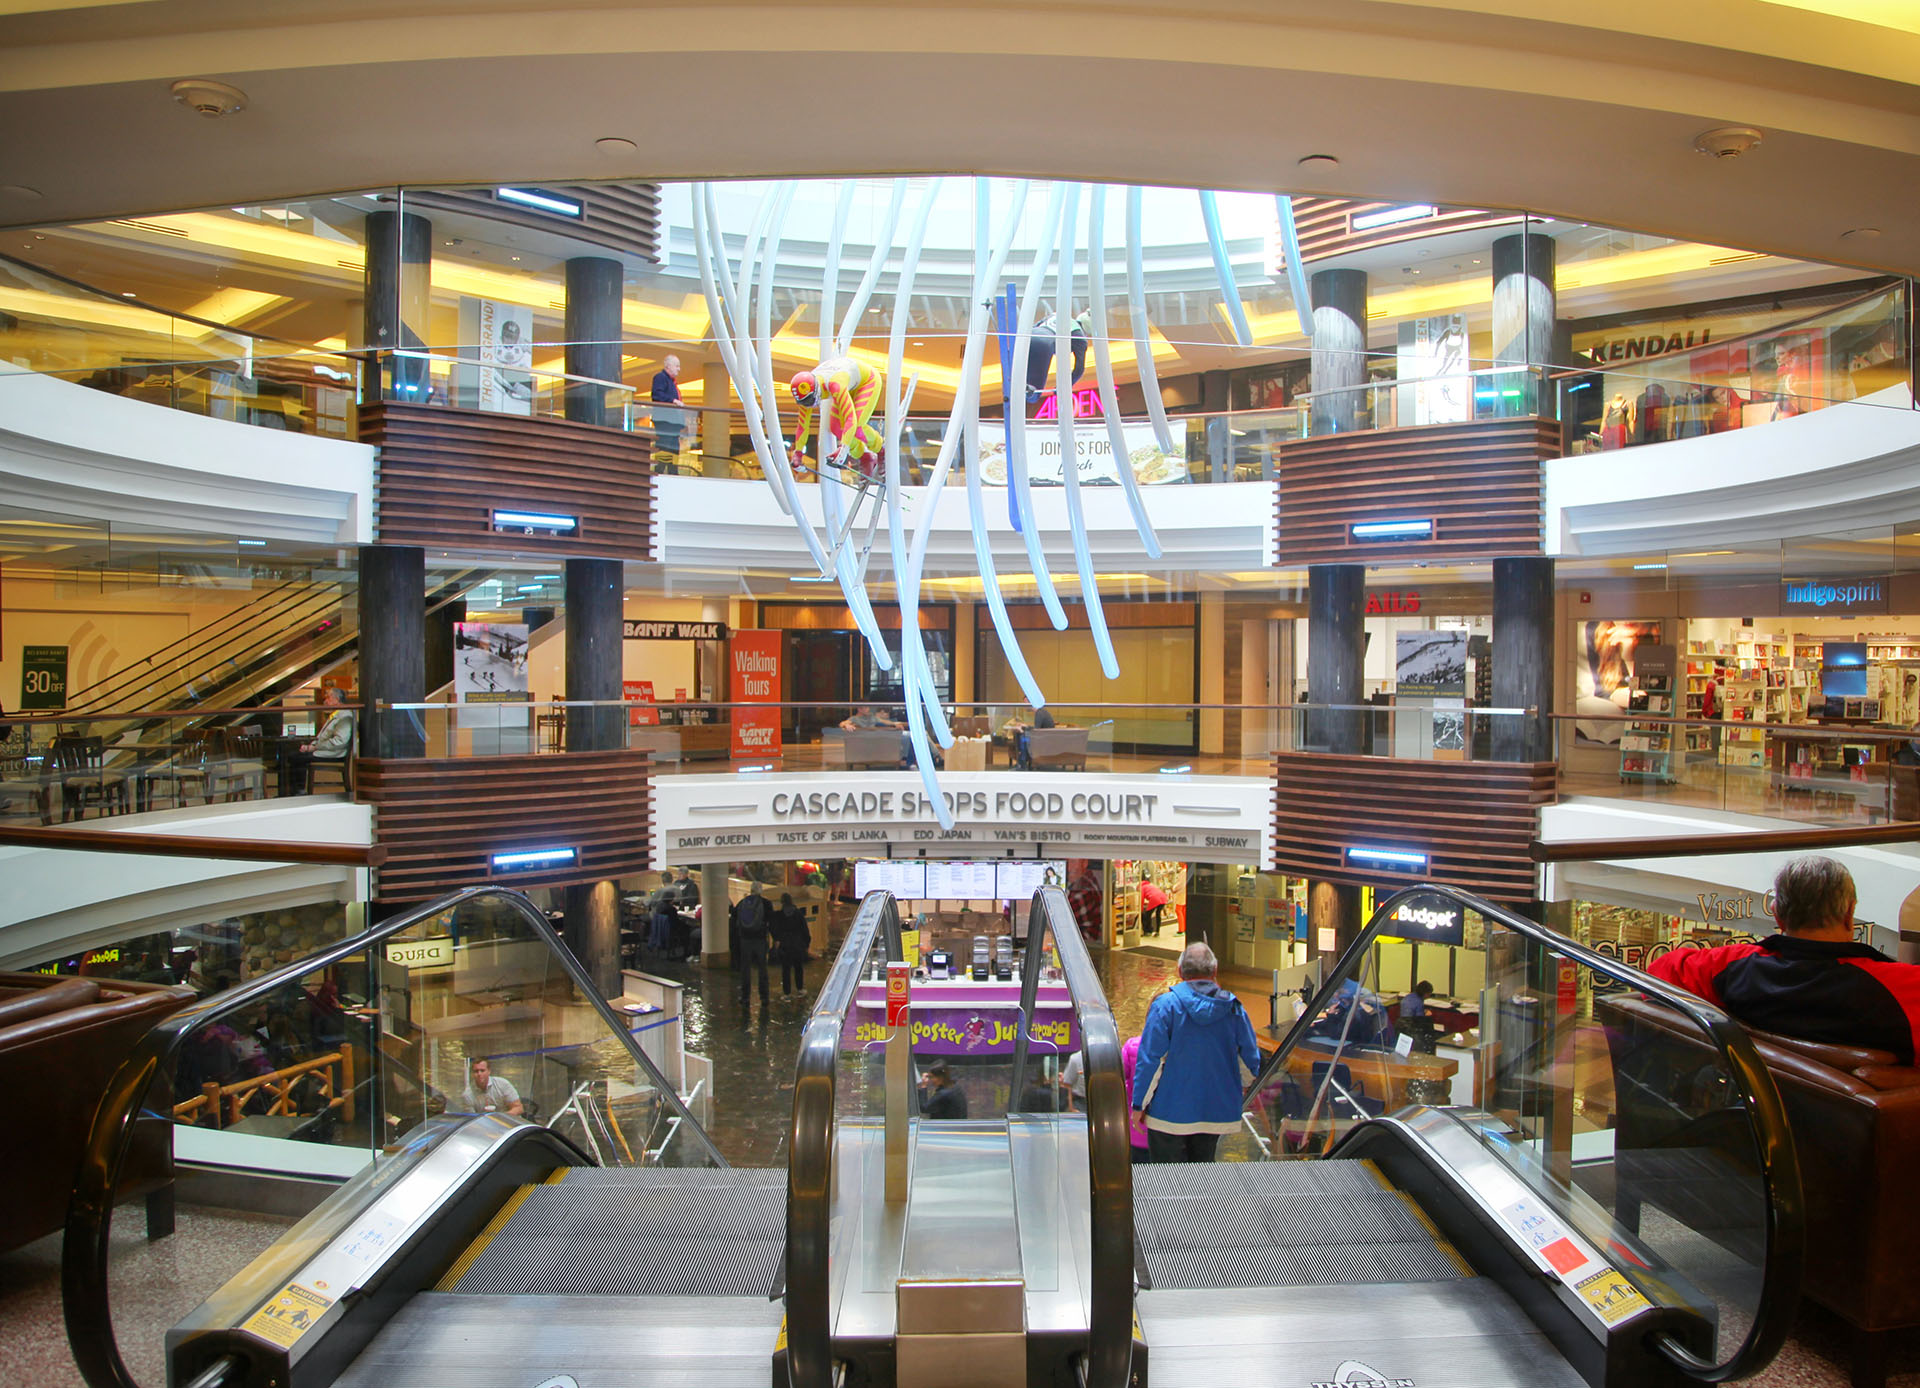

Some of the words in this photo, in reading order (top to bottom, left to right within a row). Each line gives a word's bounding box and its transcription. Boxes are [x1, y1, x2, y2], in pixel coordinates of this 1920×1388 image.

[481, 351, 494, 403] THOMS
[1089, 441, 1111, 455] FOR
[624, 622, 675, 638] BANFF
[678, 624, 718, 638] WALK
[735, 650, 777, 677] Walking
[25, 671, 50, 693] 30
[51, 683, 64, 692] OFF
[742, 674, 770, 696] Tours
[739, 728, 775, 737] BANFF
[742, 736, 772, 745] WALK
[772, 792, 894, 815] CASCADE
[996, 792, 1063, 815] FOOD
[1071, 793, 1158, 817] COURT
[679, 837, 710, 848] DAIRY
[715, 834, 750, 845] QUEEN
[777, 832, 808, 842] TASTE
[813, 832, 827, 841] OF
[832, 831, 848, 841] SRI
[852, 830, 888, 841] LANKA
[914, 830, 934, 840] EDO
[938, 830, 972, 840] JAPAN
[994, 830, 1026, 841] YAN'S
[1030, 831, 1071, 842] BISTRO
[1205, 836, 1248, 848] SUBWAY
[1697, 893, 1753, 921] Visit
[1399, 905, 1454, 930] Budget
[911, 1021, 965, 1046] ooster
[987, 1021, 1018, 1046] Jui
[1576, 1267, 1614, 1290] CAUTION
[291, 1286, 327, 1306] CAUTION
